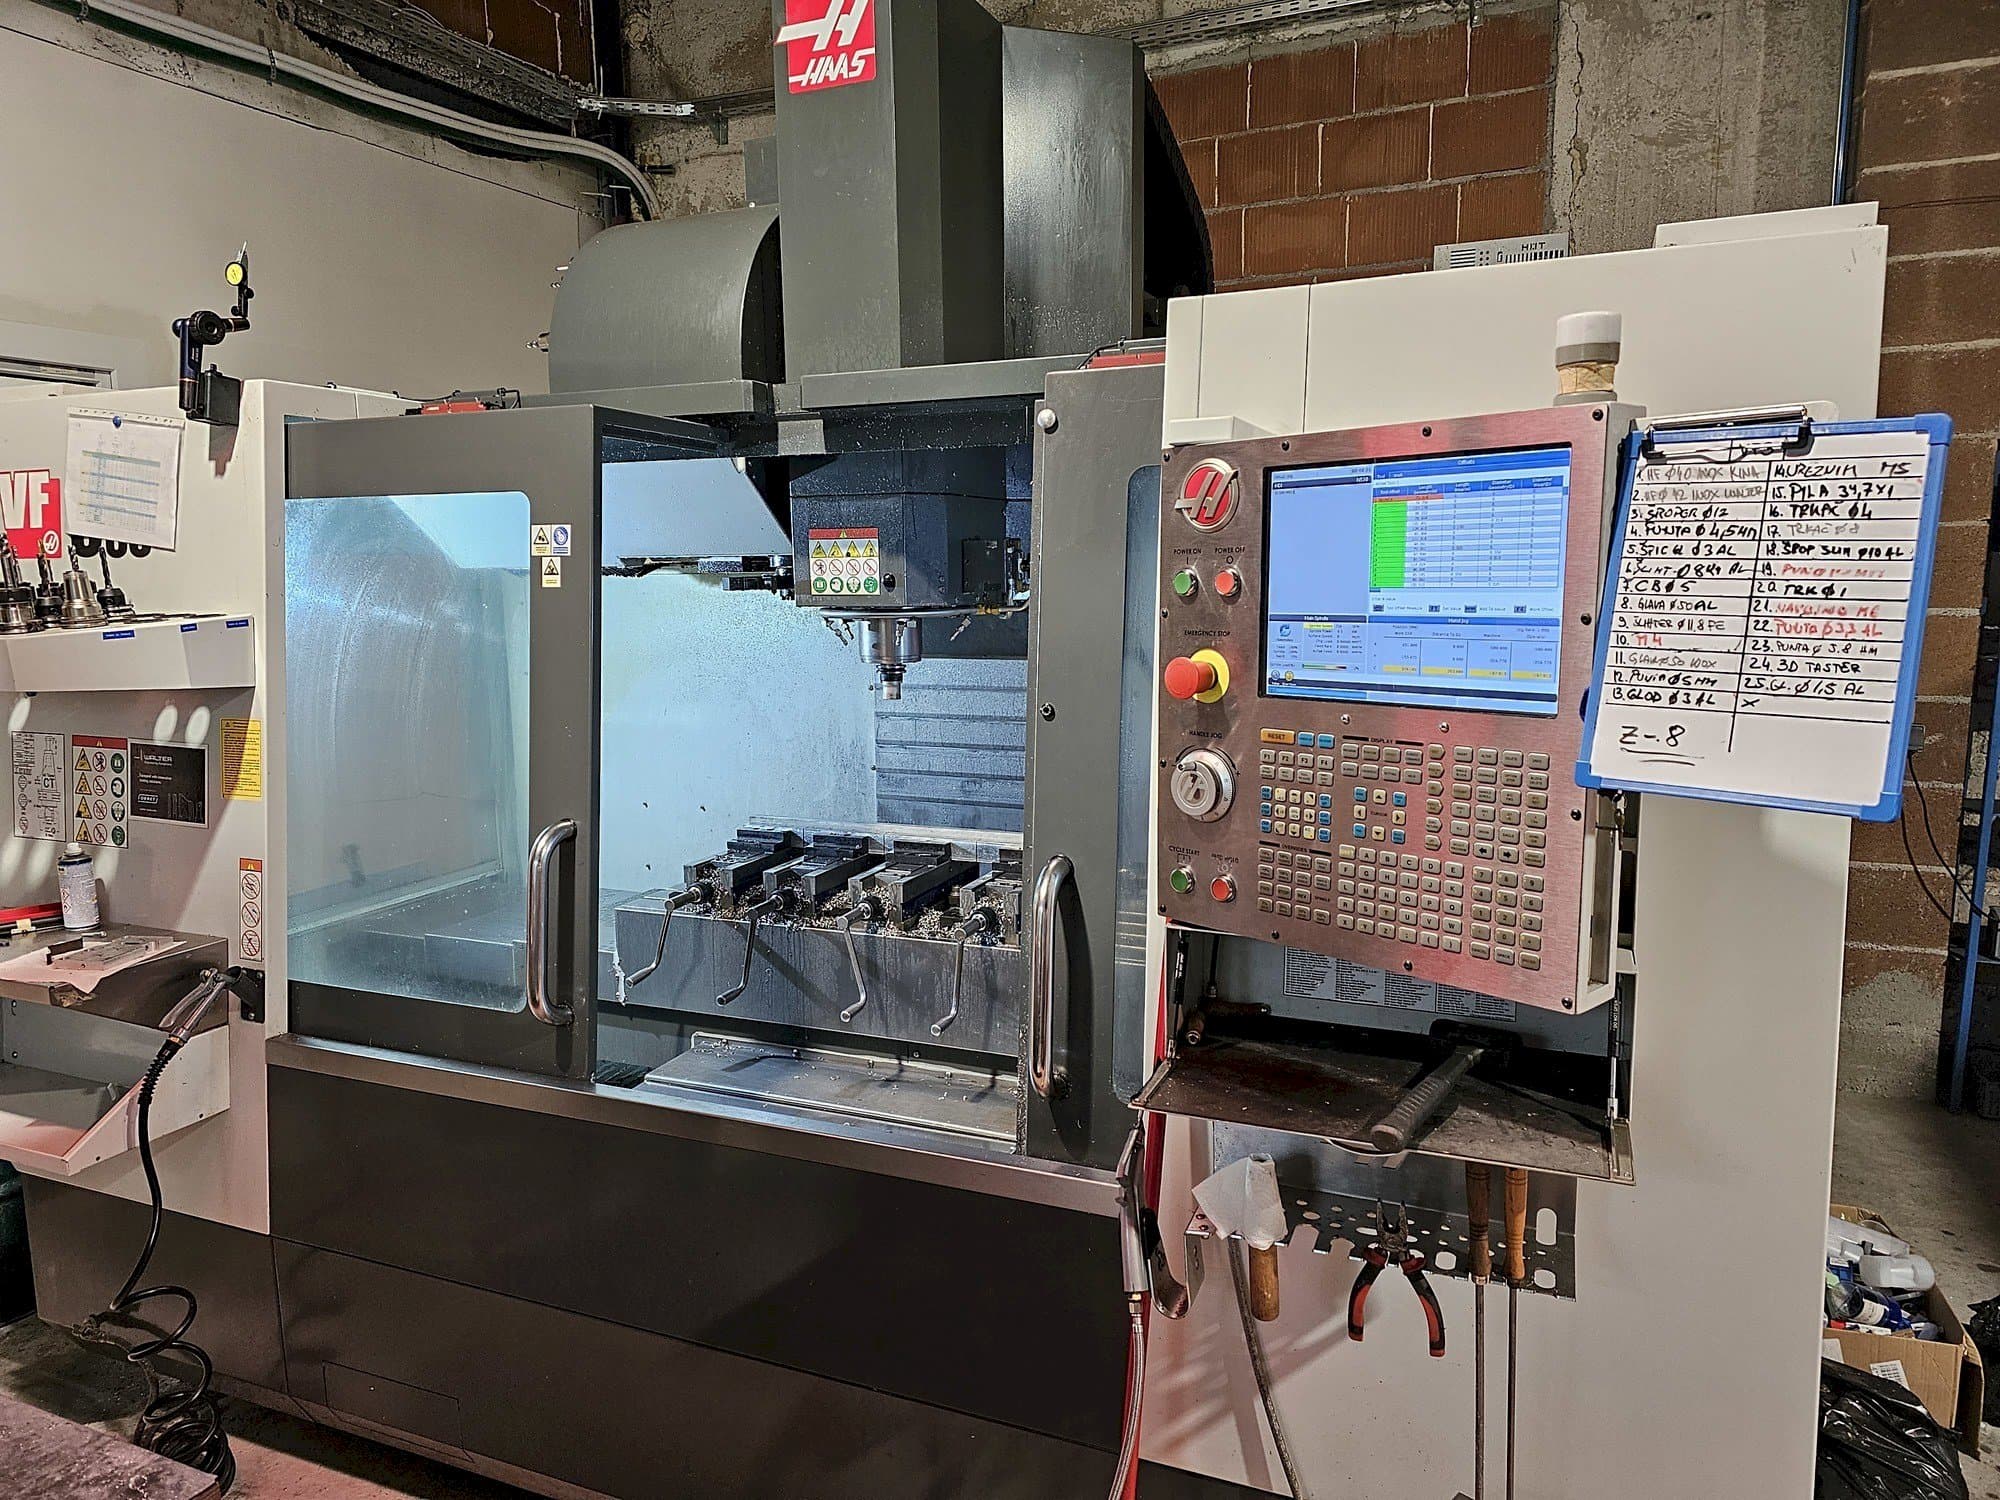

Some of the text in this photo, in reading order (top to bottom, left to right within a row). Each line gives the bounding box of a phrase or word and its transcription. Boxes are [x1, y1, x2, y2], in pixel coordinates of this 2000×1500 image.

[789, 47, 875, 87] HAAS
[0, 470, 50, 529] VF
[1805, 661, 1861, 674] TASTER
[1267, 732, 1285, 740] RESET
[144, 754, 172, 762] WALTER
[43, 777, 56, 789] CT
